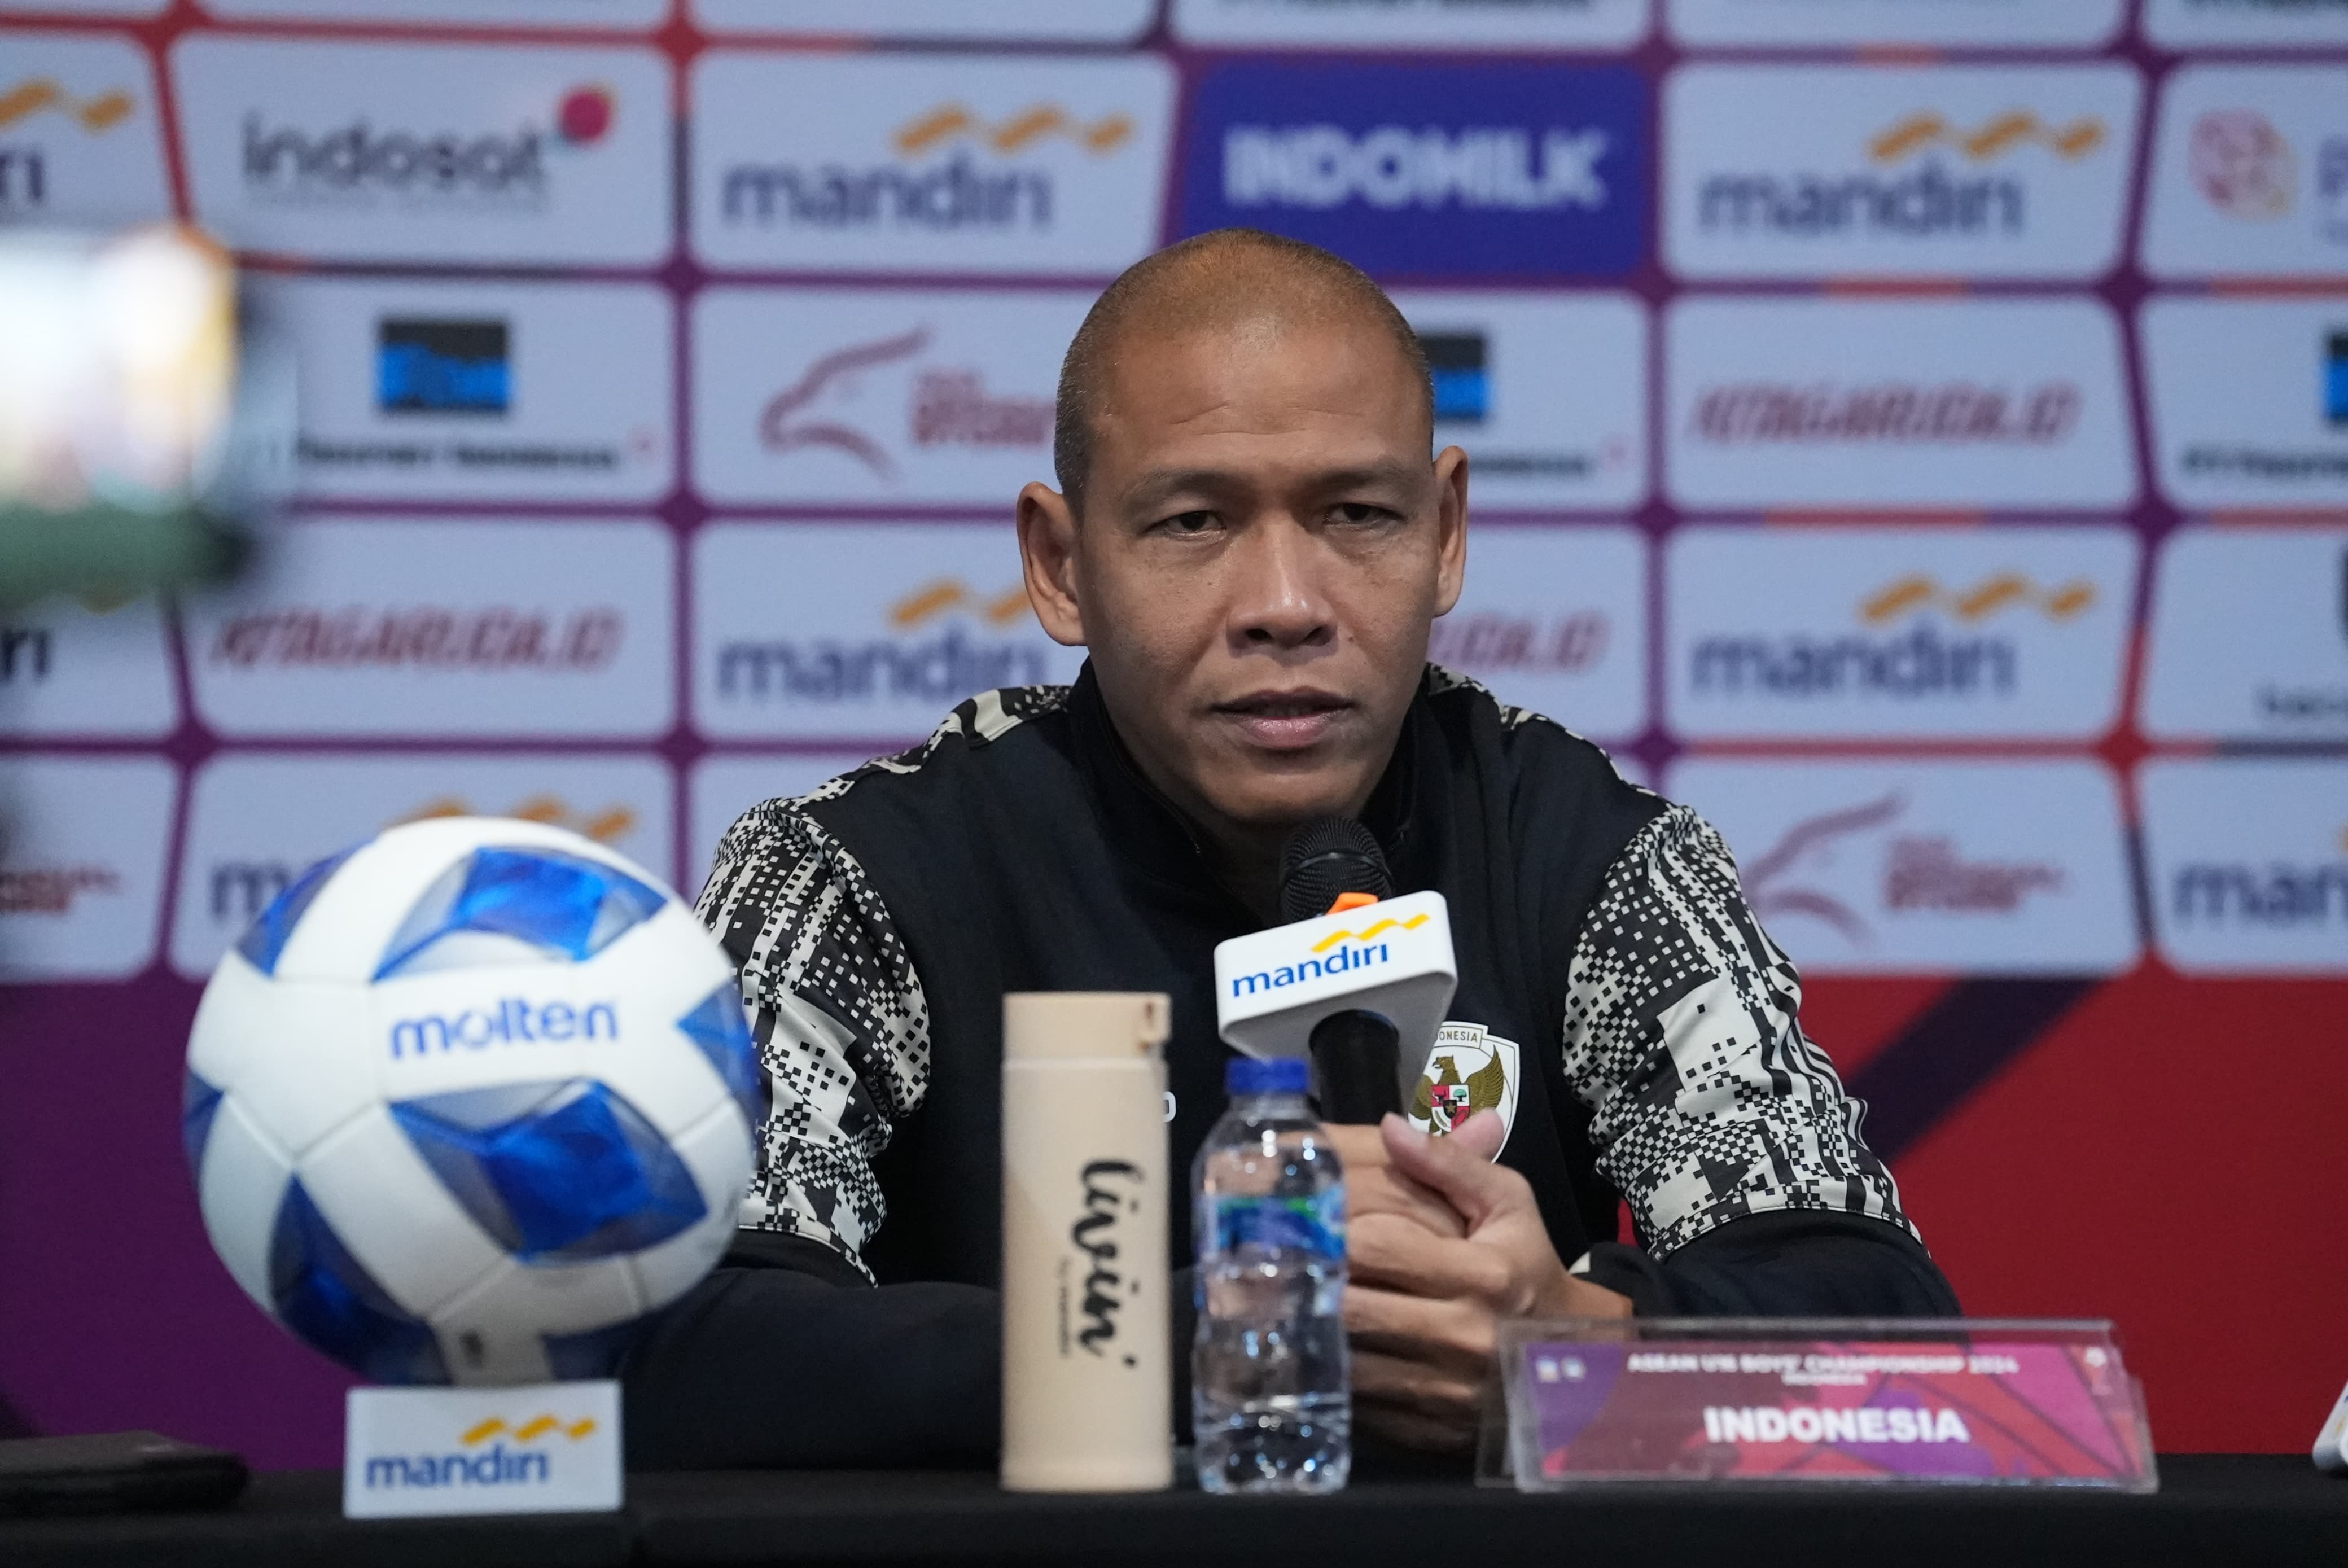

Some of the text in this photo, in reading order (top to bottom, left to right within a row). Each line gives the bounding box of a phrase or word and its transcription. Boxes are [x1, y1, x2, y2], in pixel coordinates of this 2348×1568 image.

[721, 150, 1052, 232] mandiri
[1222, 125, 1609, 208] INDOMILK
[1698, 157, 2025, 237] mandiri
[716, 623, 1049, 702] mandiri
[1691, 619, 2017, 700] mandiri
[1232, 943, 1388, 997] mandiri
[388, 997, 619, 1059] molten
[1436, 1030, 1478, 1042] ONESIA
[1702, 1405, 1971, 1443] INDONESIA
[365, 1443, 550, 1488] mandiri
